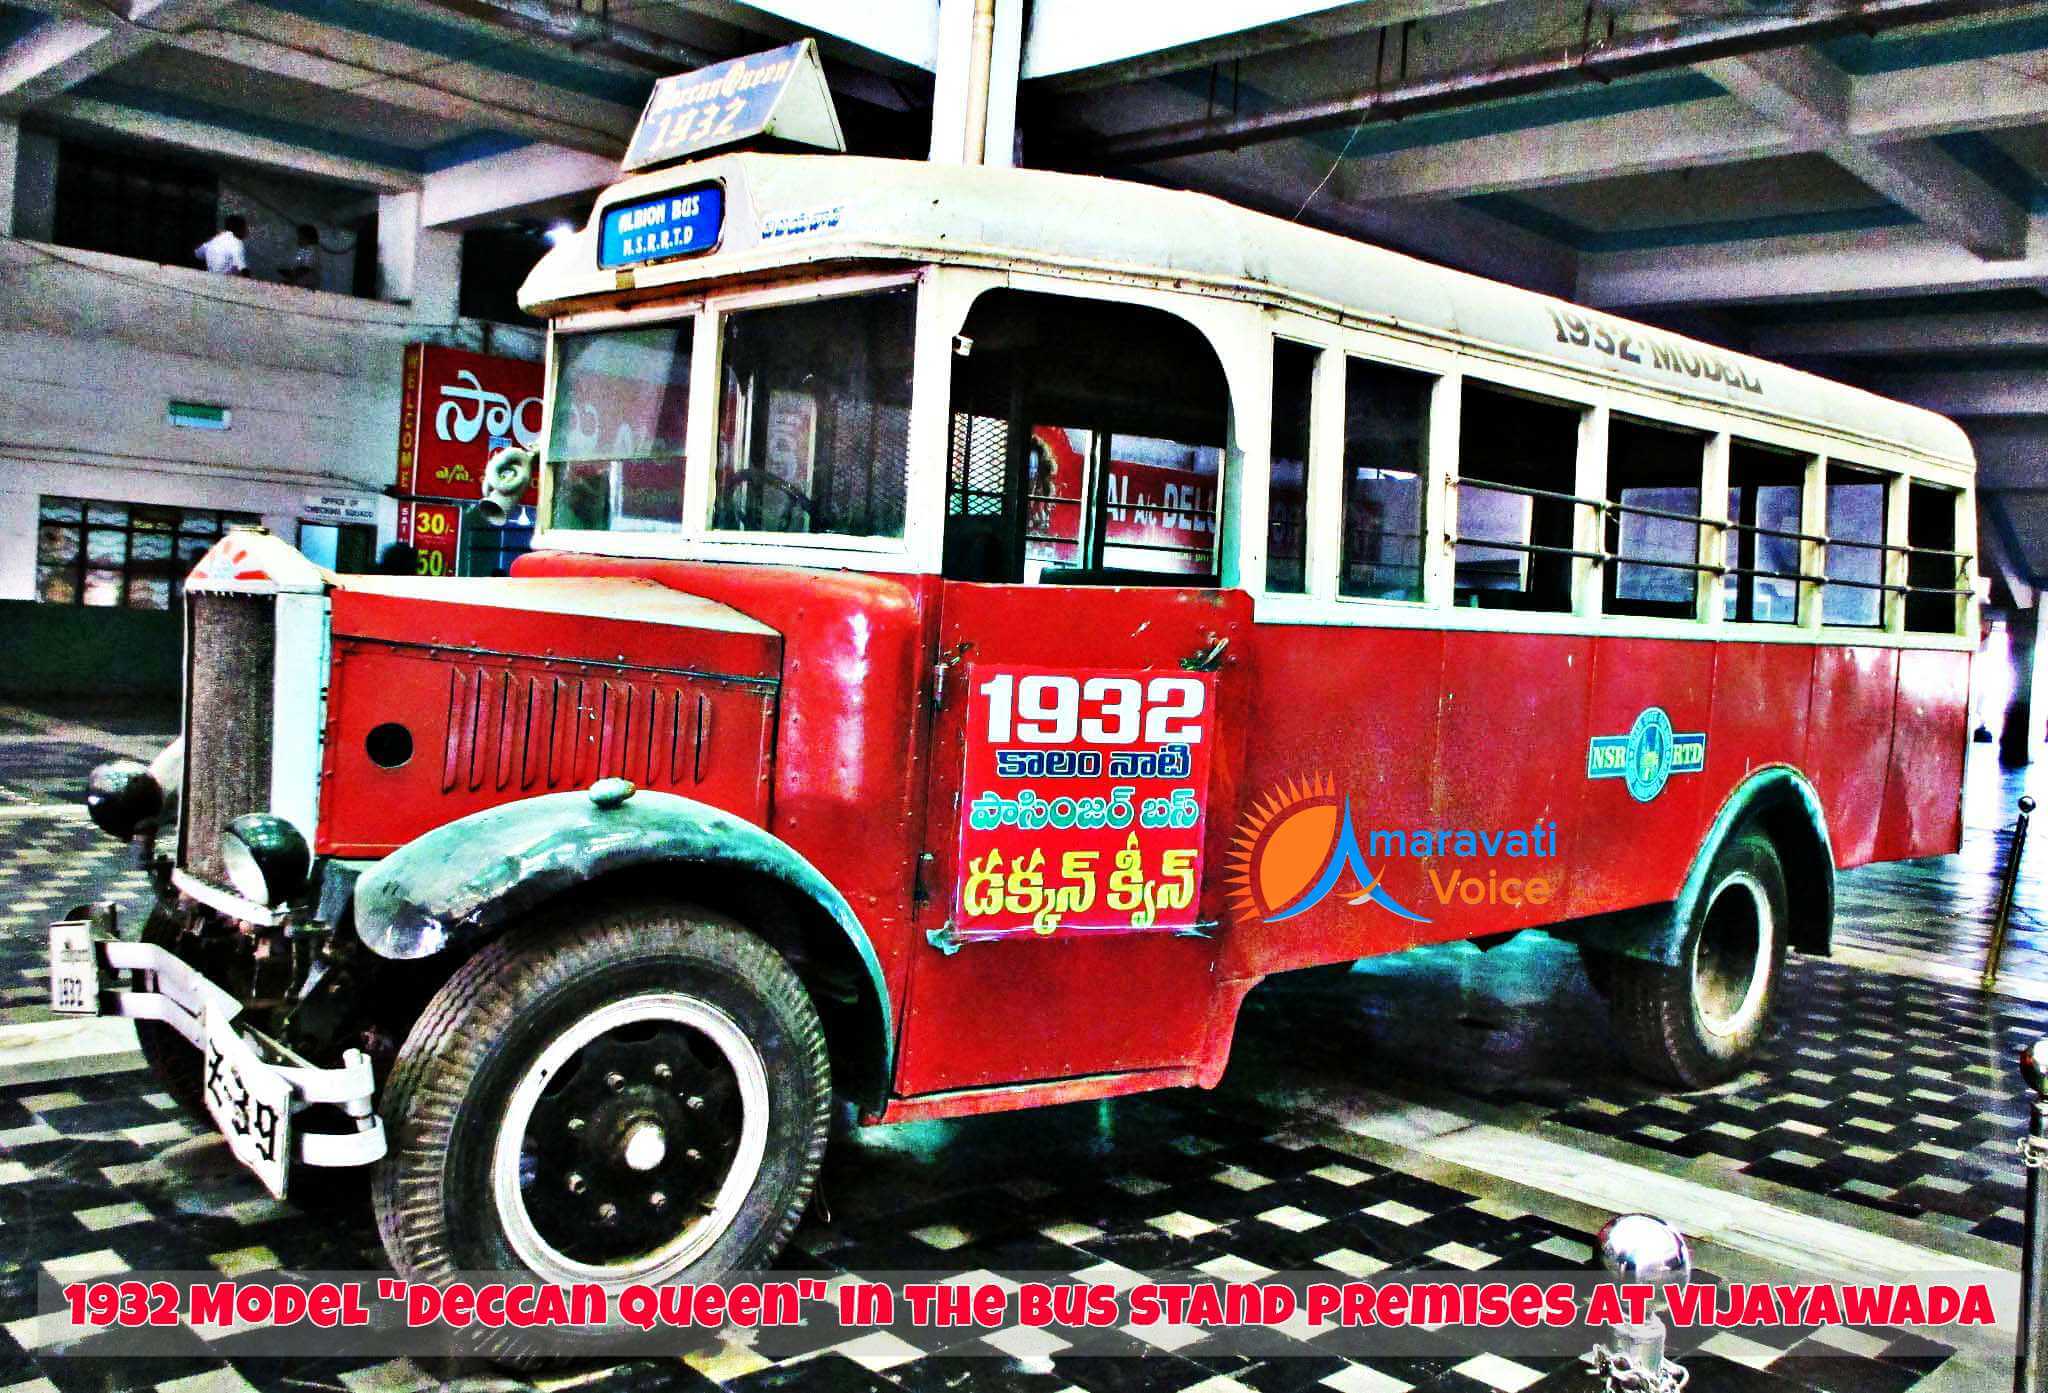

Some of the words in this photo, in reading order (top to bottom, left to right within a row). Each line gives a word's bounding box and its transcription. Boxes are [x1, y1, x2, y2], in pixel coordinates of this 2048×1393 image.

[650, 97, 746, 148] 1932
[671, 195, 700, 220] BUS
[980, 674, 1206, 744] 1932
[997, 750, 1102, 779] కాలం
[1108, 743, 1192, 779] నాటి
[1671, 743, 1703, 765] RTD
[969, 786, 1136, 830] పాసింజర్
[1140, 788, 1200, 830] బస్
